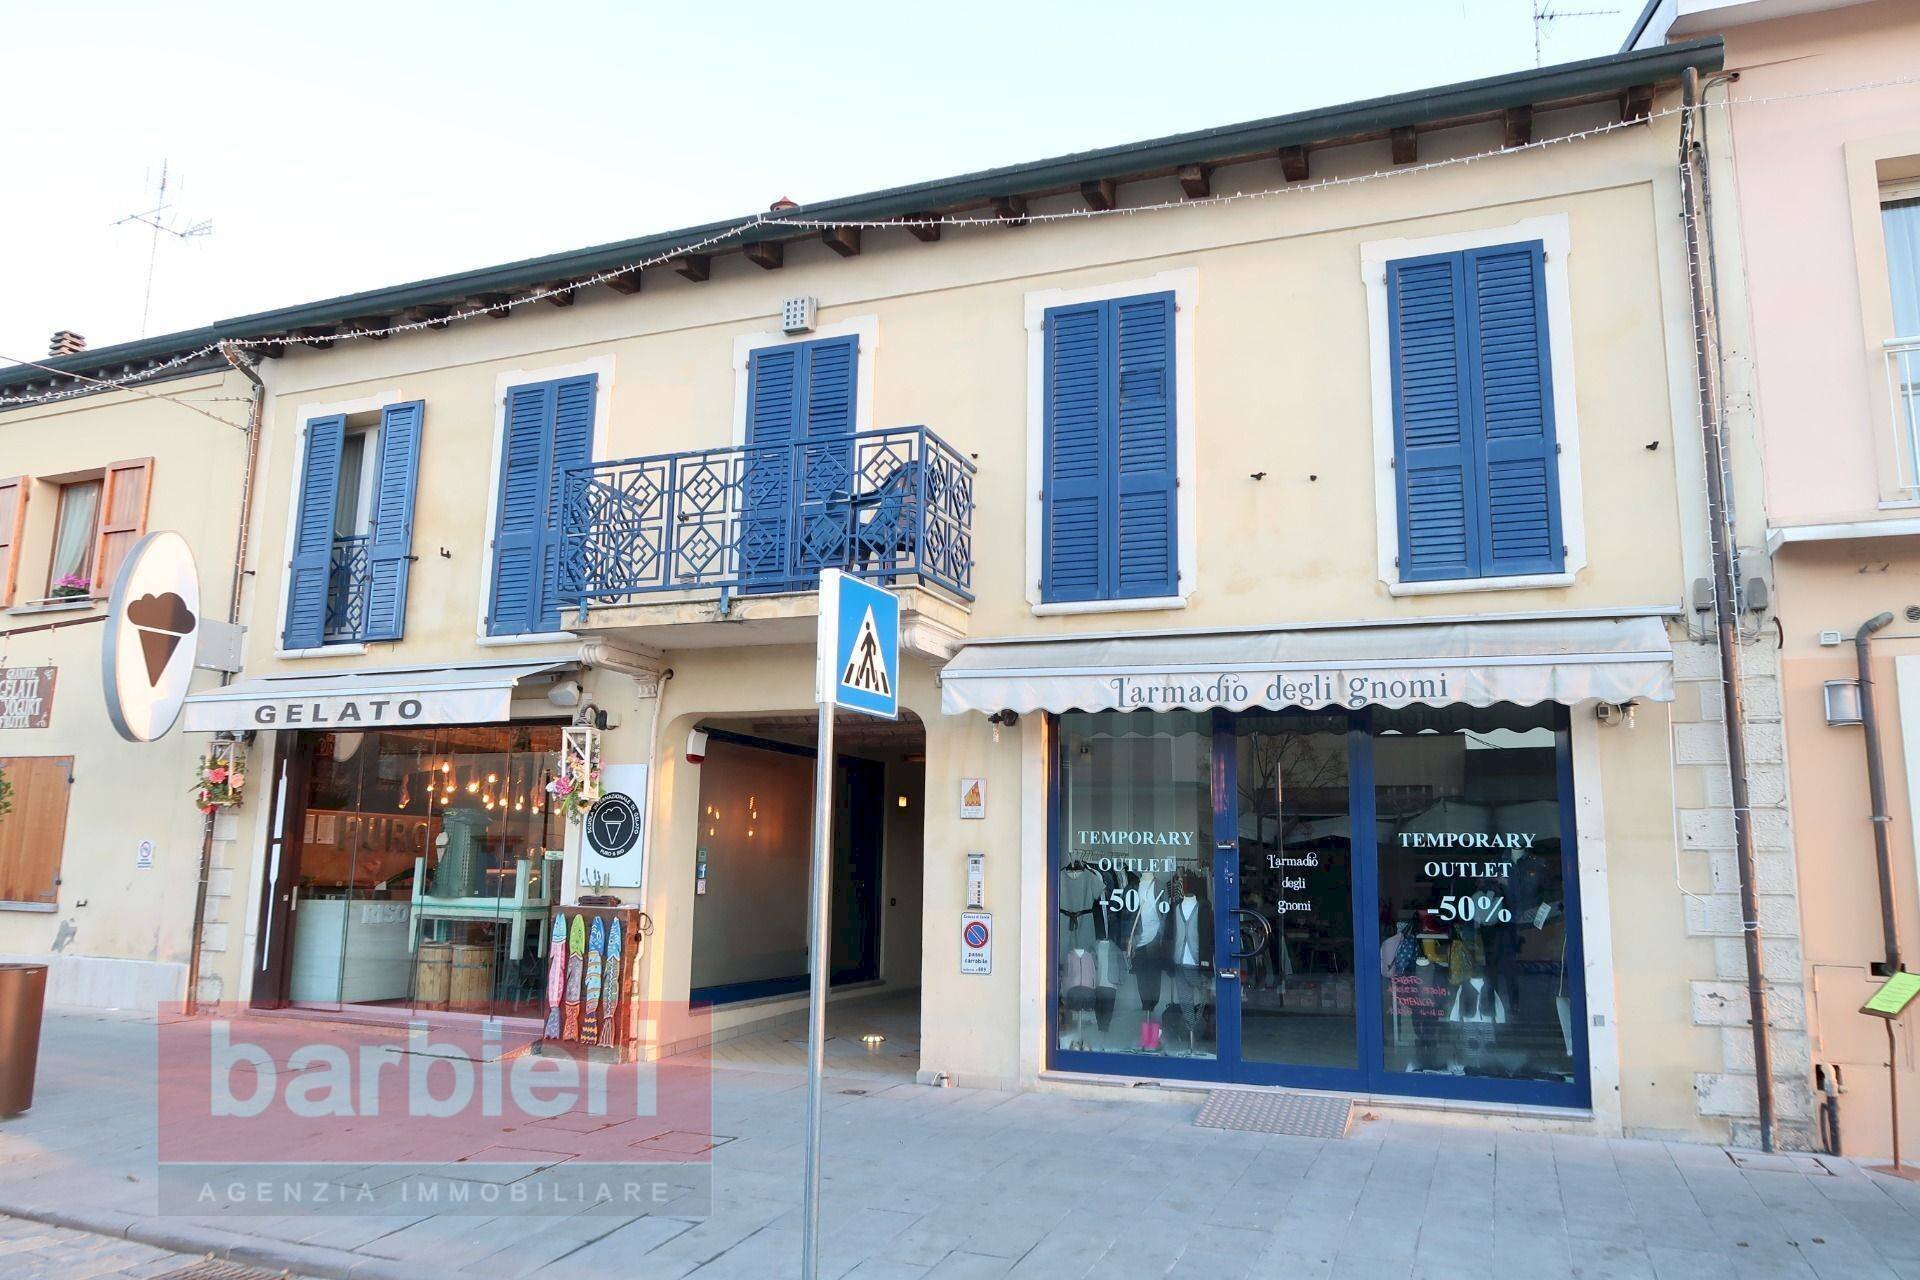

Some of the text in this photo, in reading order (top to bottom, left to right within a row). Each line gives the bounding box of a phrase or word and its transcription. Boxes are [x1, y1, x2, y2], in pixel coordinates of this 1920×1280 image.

[1110, 672, 1449, 708] L'armadio degli gnomi
[255, 699, 423, 724] GELATO
[1078, 830, 1194, 846] TEMPORARY
[1398, 832, 1536, 849] TEMPORARY
[1098, 857, 1173, 873] OUTLET
[1266, 852, 1319, 869] L'armadio
[1424, 862, 1512, 878] OUTLET
[1281, 876, 1306, 891] degli
[1098, 888, 1171, 914] -50%
[1277, 900, 1312, 914] gnomi
[1427, 895, 1512, 923] -50%
